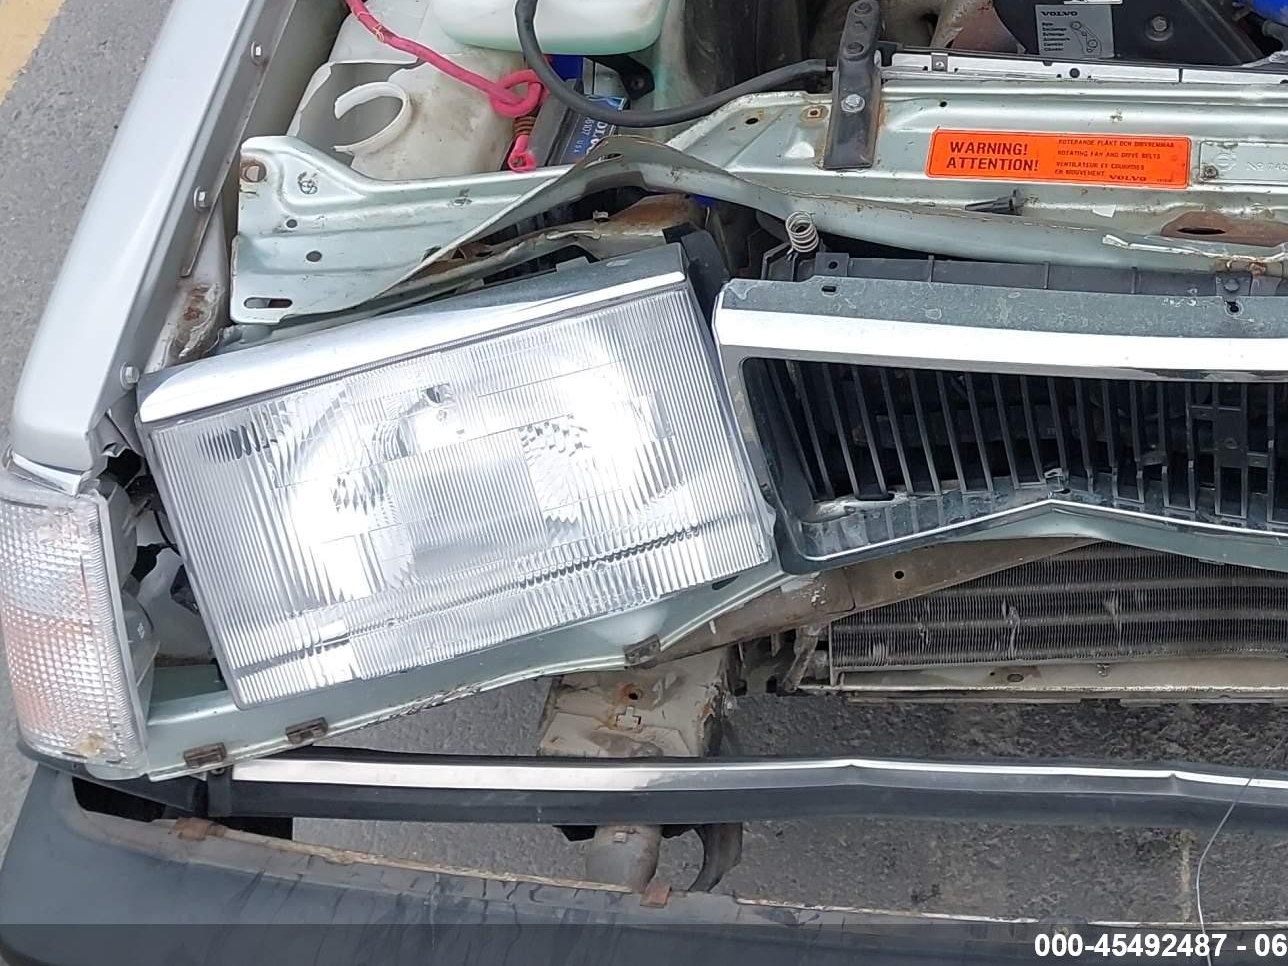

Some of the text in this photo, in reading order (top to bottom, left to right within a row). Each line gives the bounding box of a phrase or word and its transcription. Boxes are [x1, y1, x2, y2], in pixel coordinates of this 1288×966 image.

[950, 141, 1028, 155] WARNING!
[946, 157, 1039, 171] ATTENTION!
[1109, 174, 1147, 182] VOLVO
